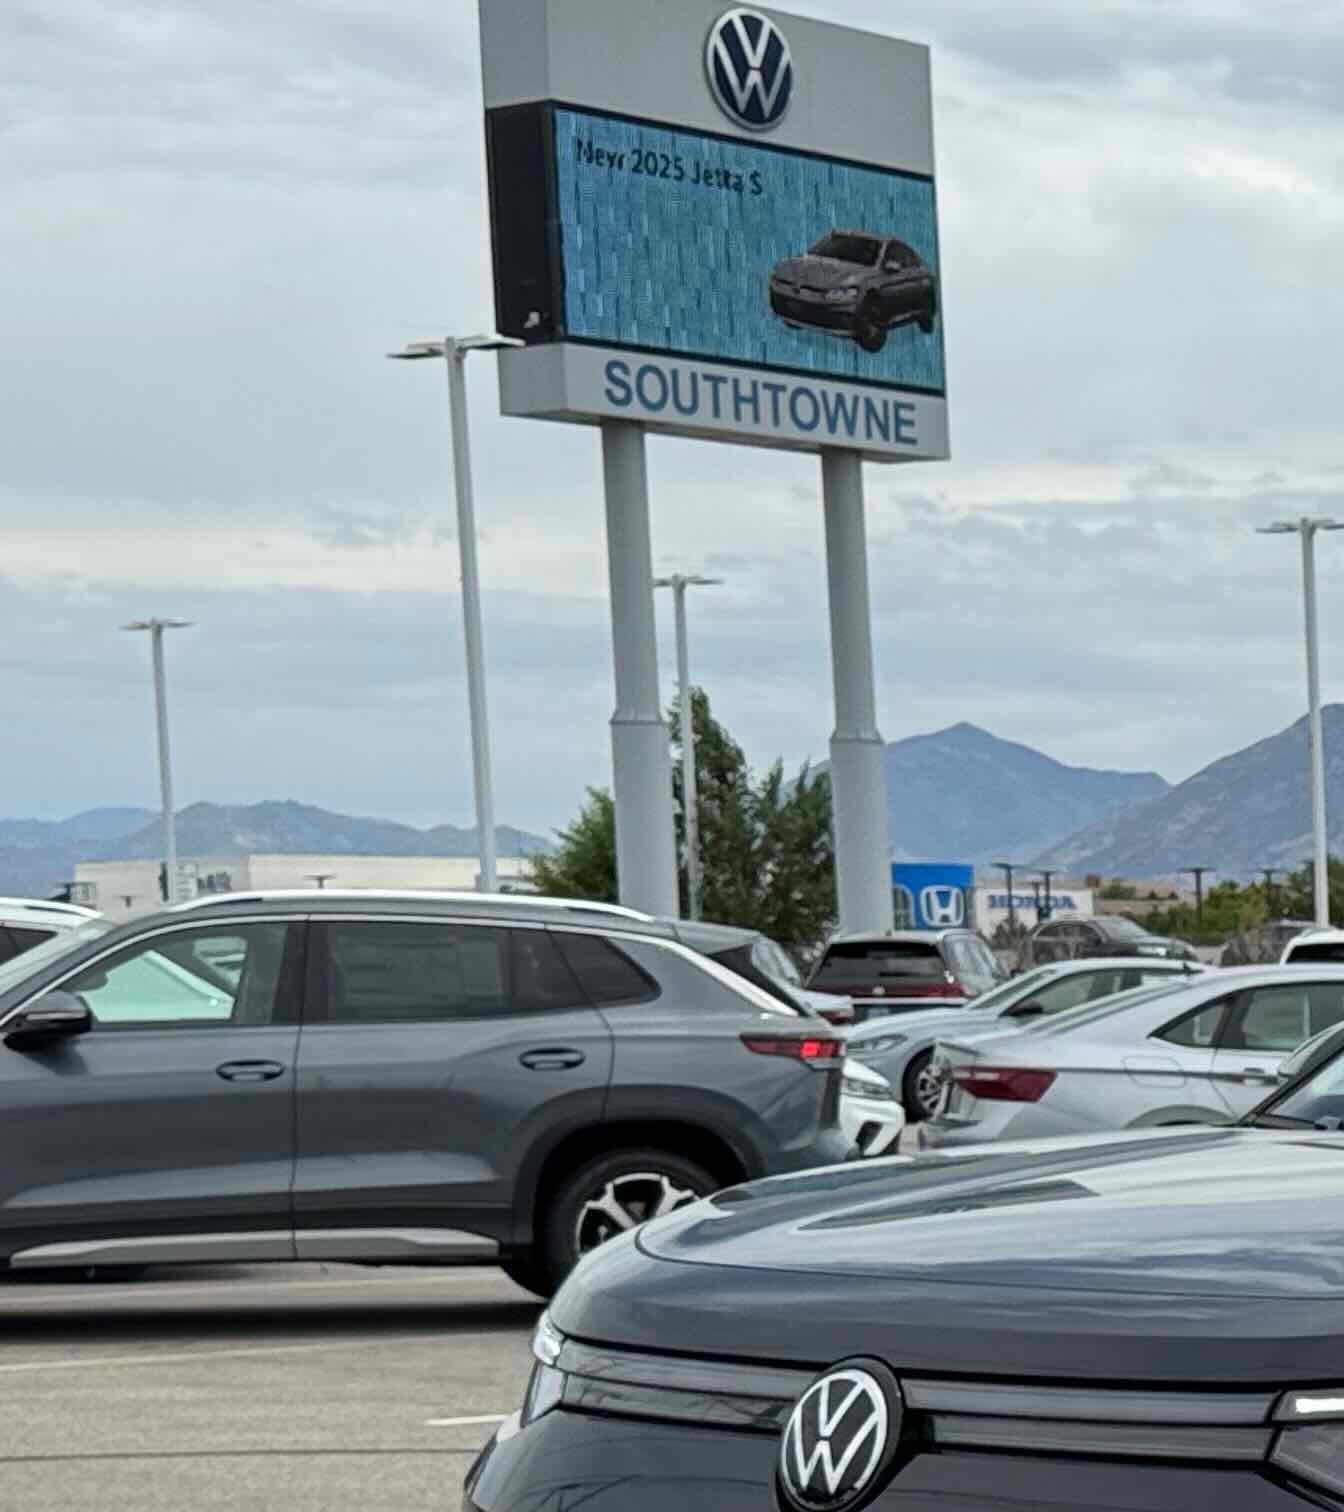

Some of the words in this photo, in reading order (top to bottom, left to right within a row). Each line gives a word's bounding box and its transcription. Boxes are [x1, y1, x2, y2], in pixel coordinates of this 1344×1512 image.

[631, 148, 685, 182] 2025
[691, 160, 745, 193] Jetta
[750, 169, 763, 195] S
[604, 359, 918, 445] SOUTHTOWNE
